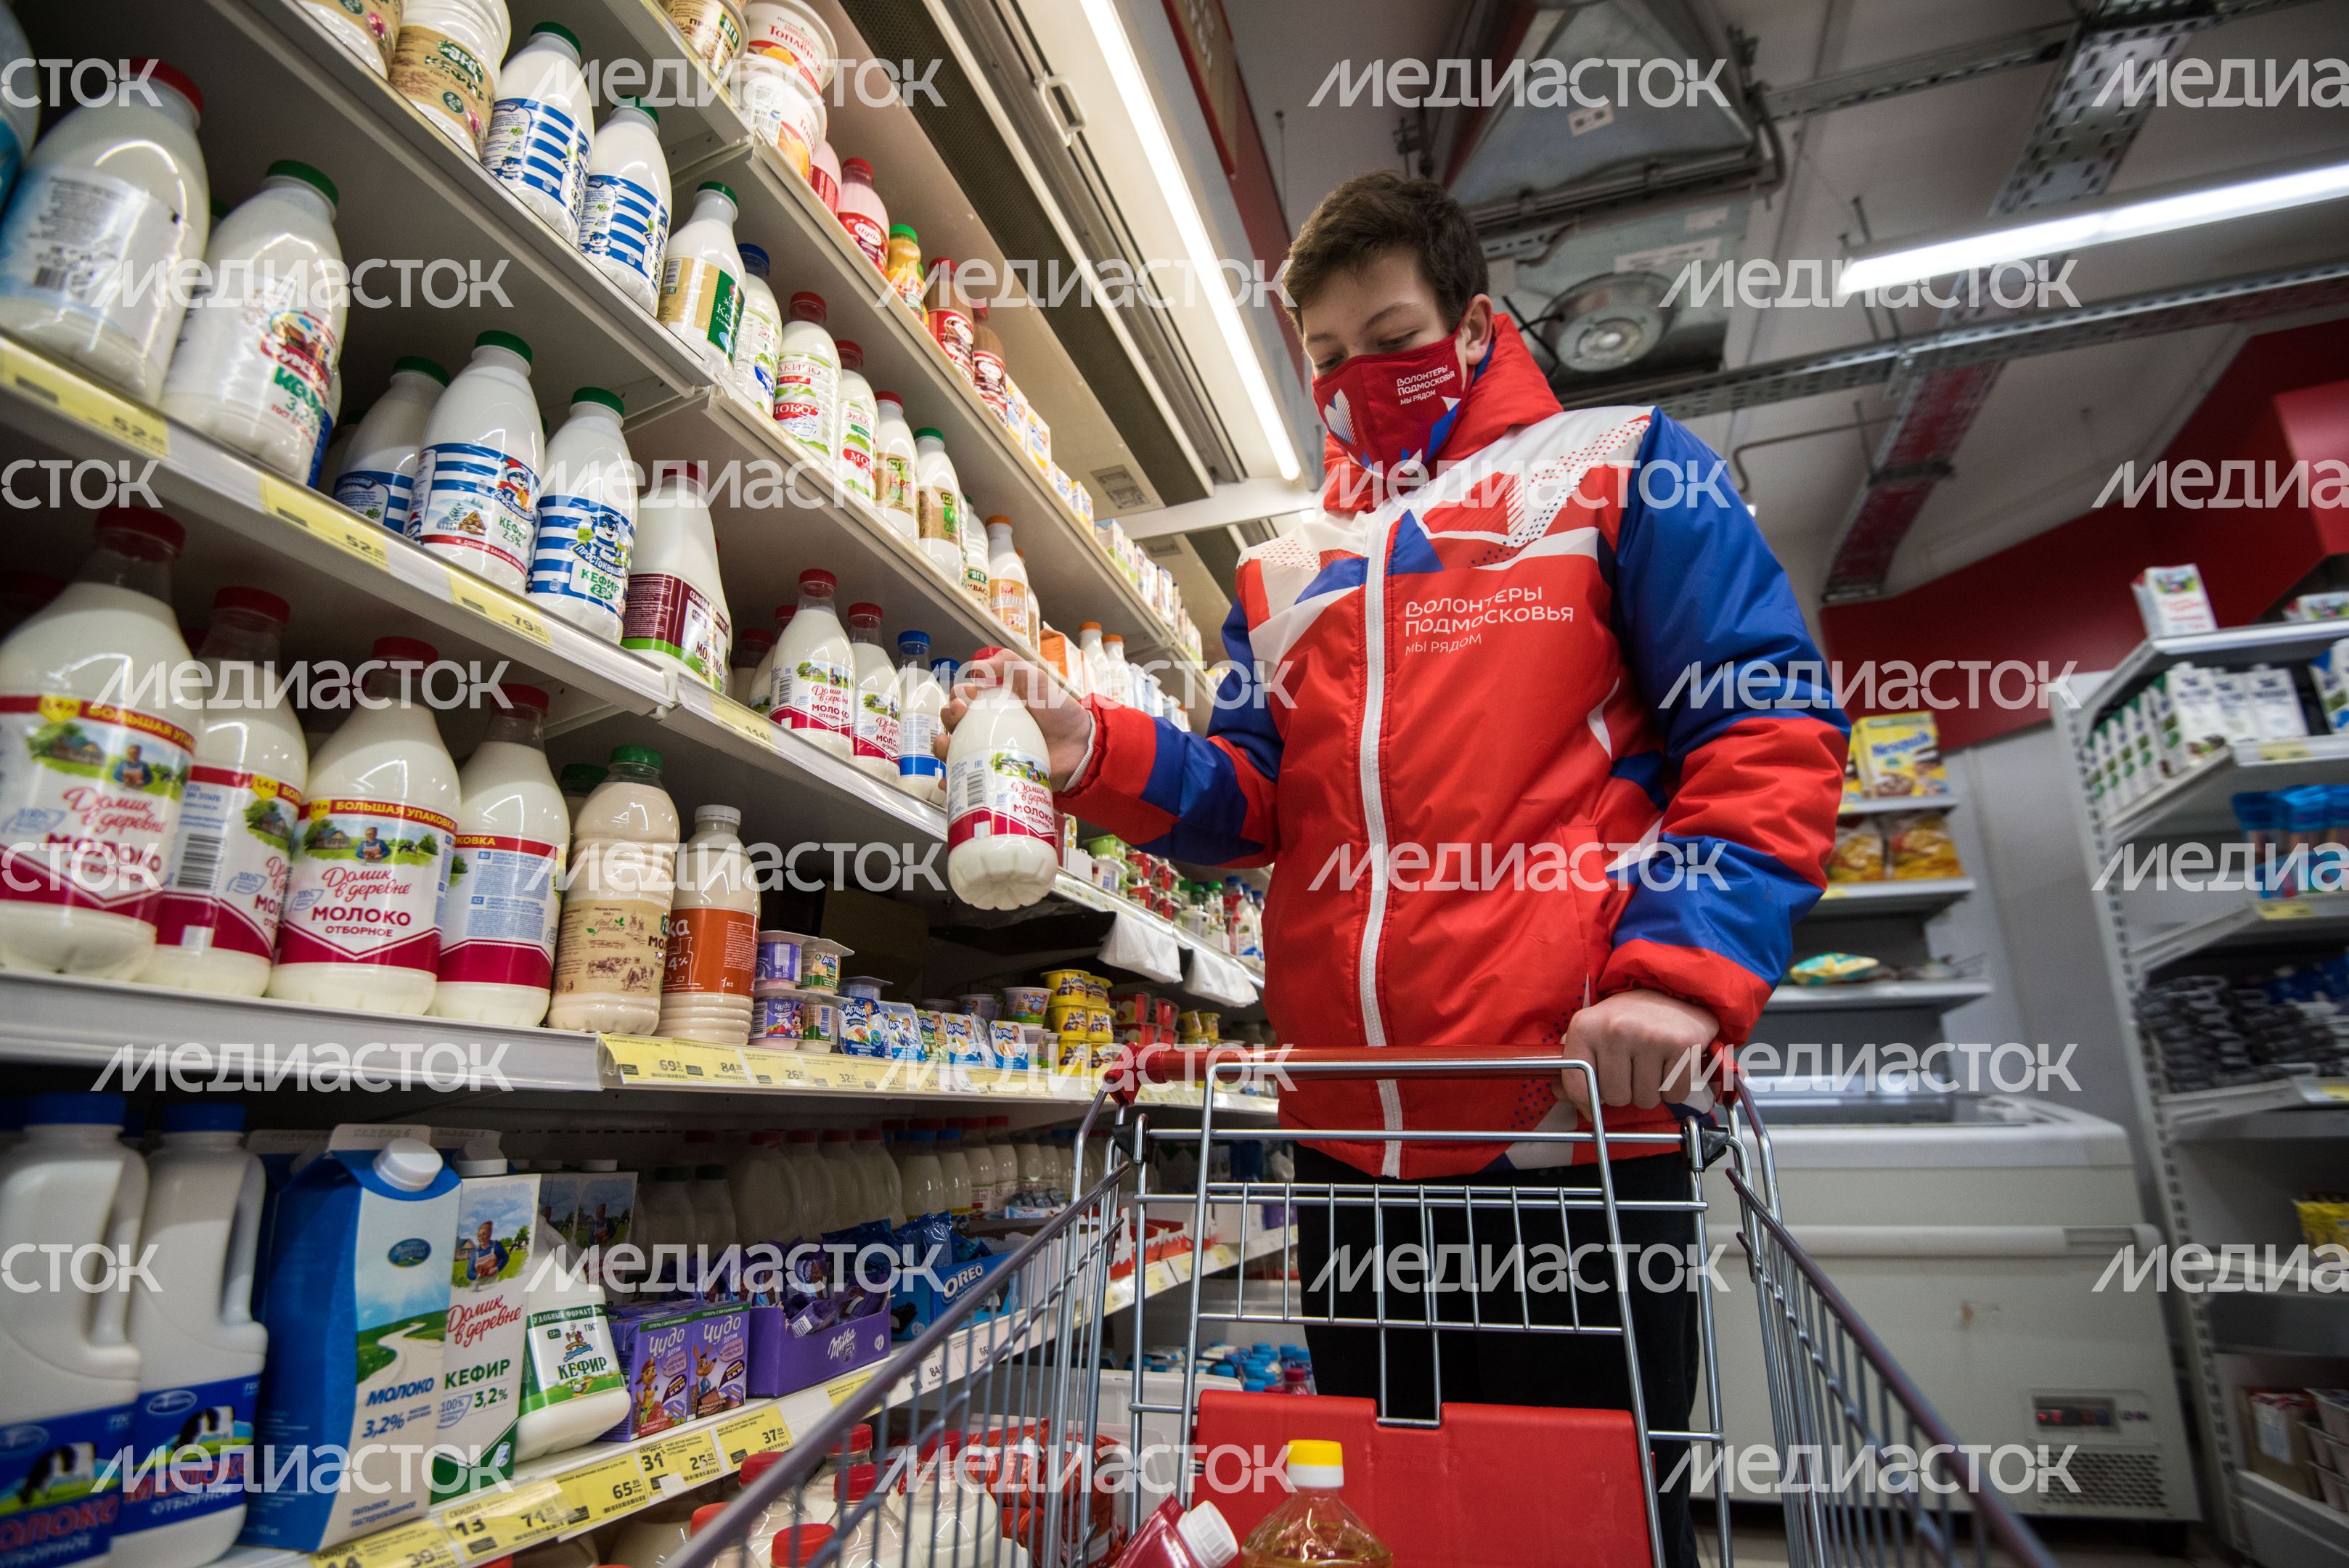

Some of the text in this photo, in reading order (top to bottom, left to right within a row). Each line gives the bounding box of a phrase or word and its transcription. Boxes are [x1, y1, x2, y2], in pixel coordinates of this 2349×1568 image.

[1397, 364, 1448, 387] ВОЛОНТЕРЫ
[1397, 370, 1455, 396] ПОДМОСКОВЬЯ
[1413, 389, 1436, 401] РЯДОМ
[581, 568, 620, 593] КЕФИР
[1406, 587, 1543, 618] ВОЛОНТЕРЫ
[512, 614, 534, 632] 79
[1405, 607, 1574, 637] ПОДМОСКОВЬЯ
[1405, 633, 1482, 656] МЫ РЯДОМ
[812, 685, 842, 696] Домик
[812, 703, 849, 719] МОЛОКО
[1011, 781, 1046, 796] Домик
[63, 786, 152, 812] Домик
[96, 813, 168, 834] деревне
[335, 801, 404, 816] БОЛЬШАЯ
[407, 807, 457, 831] УПАКОВКА
[1013, 804, 1053, 826] МОЛОКО
[322, 867, 393, 886] Домик
[345, 882, 410, 903] деревне
[312, 906, 411, 927] МОЛОКО
[594, 918, 613, 927] Vital
[325, 925, 393, 938] ОТБОРНОЕ
[597, 924, 626, 934] product
[659, 1059, 677, 1072] 69
[720, 1062, 735, 1073] 84
[838, 1074, 851, 1083] 32
[943, 1264, 984, 1299] OREO
[447, 1295, 504, 1334] Домик
[533, 1307, 591, 1324] УДОБНЫЙ ФОРМАТ
[463, 1305, 523, 1348] деревне
[584, 1323, 598, 1332] ГОСТ
[703, 1315, 741, 1345] Чудо
[649, 1327, 685, 1358] Чудо
[723, 1334, 738, 1344] ДЕТКИ
[828, 1328, 857, 1360] Milka
[666, 1346, 682, 1358] ДЕТКИ
[444, 1358, 510, 1390] КЕФИР
[557, 1357, 607, 1380] КЕФИР
[929, 1365, 941, 1377] 84
[366, 1377, 435, 1407] МОЛОКО
[474, 1387, 508, 1408] 3,2%
[441, 1397, 464, 1412] 100%
[361, 1413, 405, 1438] 3,2%
[762, 1429, 778, 1444] 37
[642, 1452, 664, 1471] 31
[690, 1453, 709, 1471] 25
[613, 1482, 633, 1499] 65
[449, 1503, 482, 1519] СКИДКА
[454, 1517, 487, 1536] 13
[406, 1548, 436, 1564] 39
